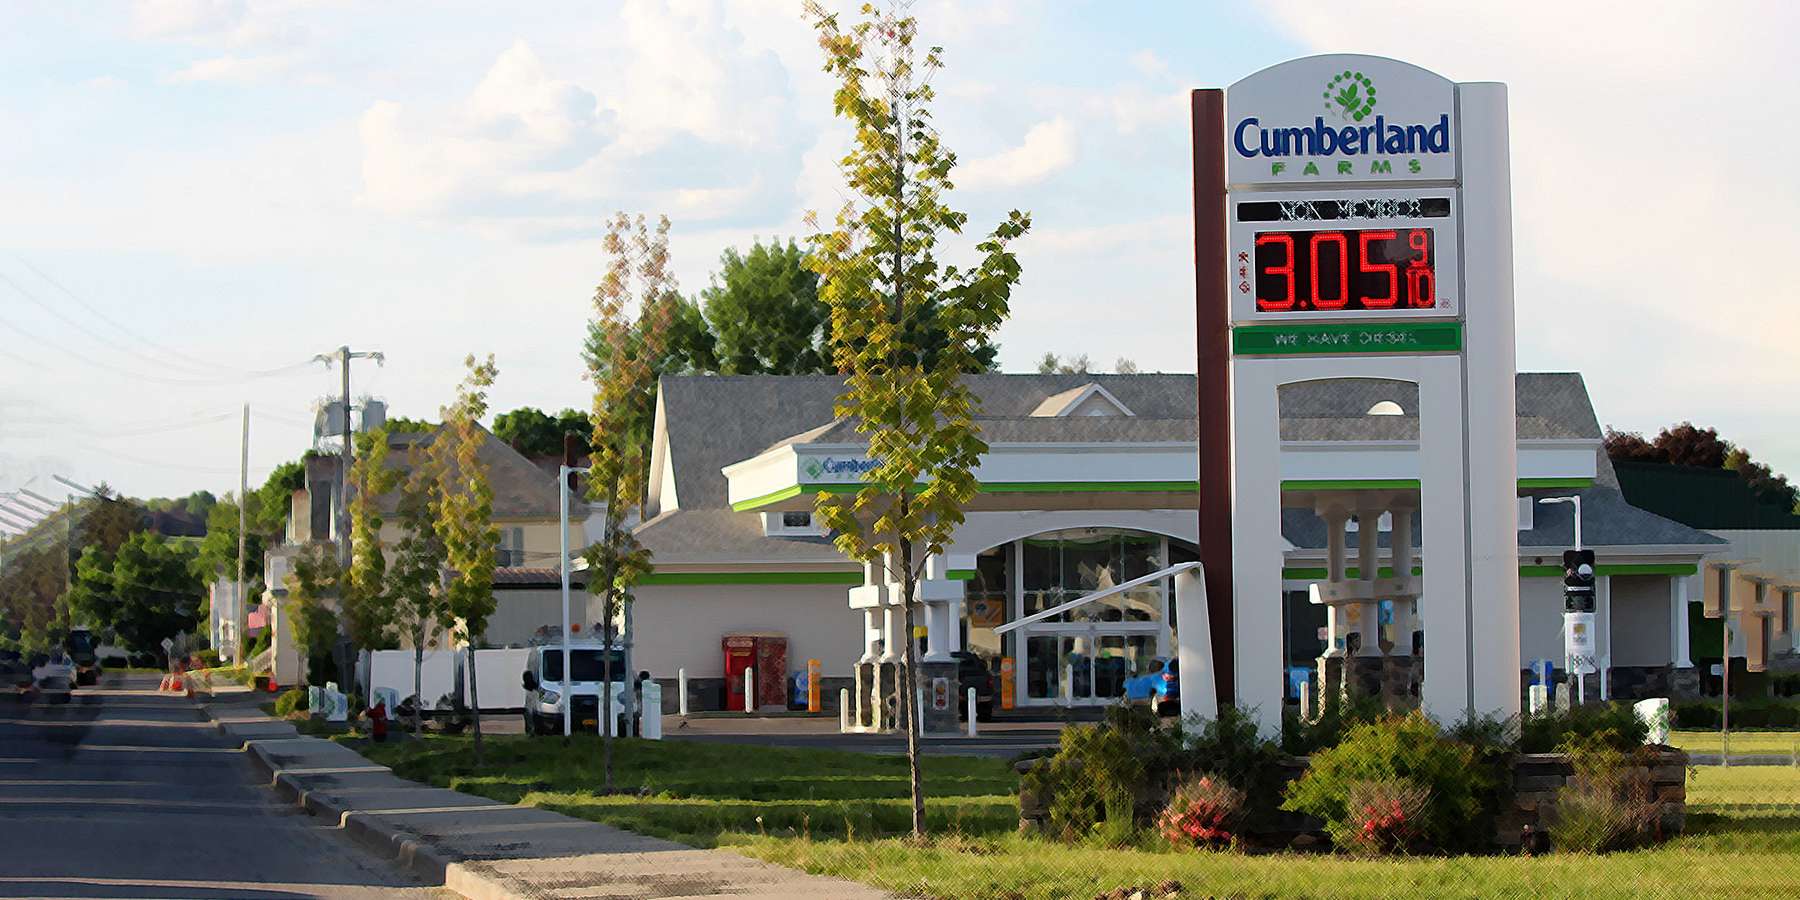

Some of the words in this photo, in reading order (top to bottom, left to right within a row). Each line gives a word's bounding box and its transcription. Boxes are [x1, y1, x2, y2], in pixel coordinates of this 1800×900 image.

[1234, 114, 1450, 157] Cumberland
[1271, 159, 1422, 176] FARMS
[1275, 333, 1298, 346] WE
[1307, 332, 1350, 345] HAVE
[1359, 331, 1417, 345] DIESEL
